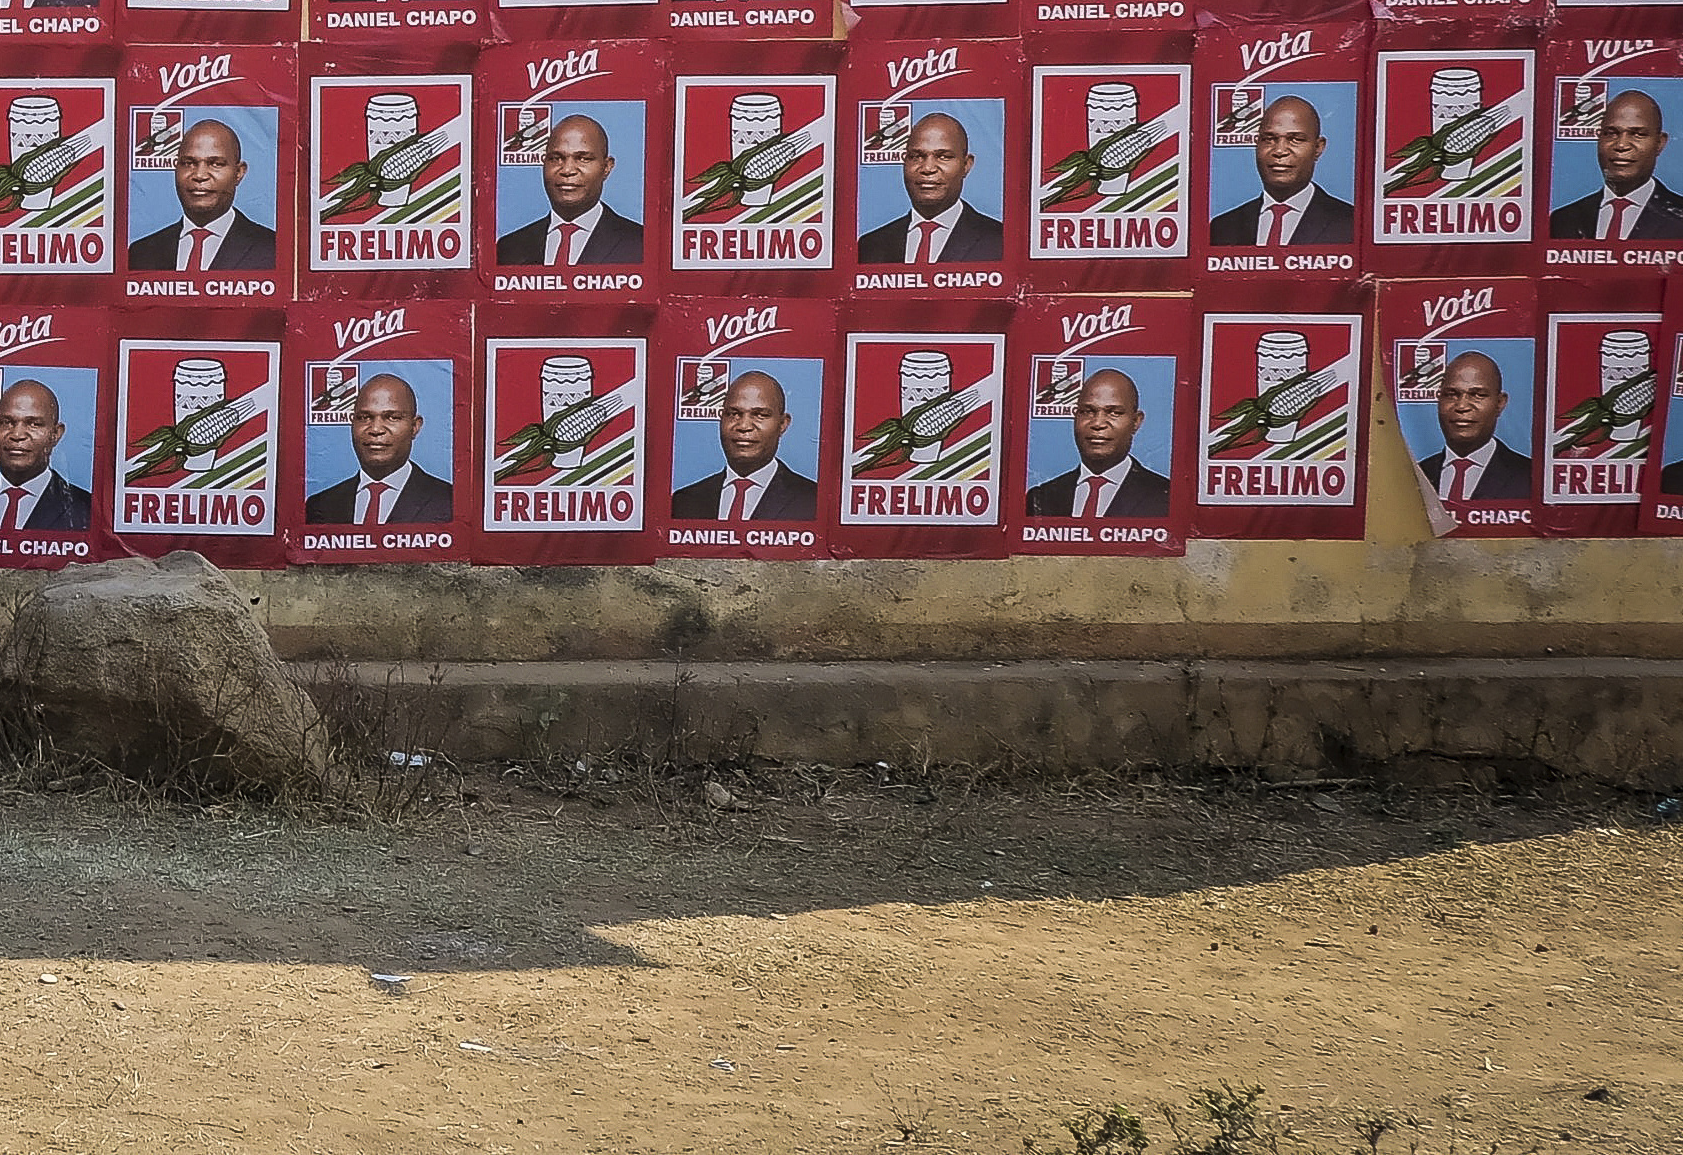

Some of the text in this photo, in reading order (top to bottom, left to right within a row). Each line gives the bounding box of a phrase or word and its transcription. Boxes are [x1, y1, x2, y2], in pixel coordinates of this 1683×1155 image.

[30, 18, 99, 32] CHAPO
[328, 10, 476, 27] DANIEL CHAPO
[671, 10, 814, 26] DANIEL CHAPO
[1039, 2, 1184, 19] DANIEL CHAPO
[1241, 31, 1312, 70] Vota
[159, 54, 231, 93] Vota
[527, 49, 598, 89] Vota
[888, 48, 957, 87] Vota
[1384, 202, 1521, 234] FRELIMO
[320, 229, 461, 260] FRELIMO
[683, 229, 822, 259] FRELIMO
[1040, 218, 1178, 249] FRELIMO
[1208, 255, 1352, 271] DANIEL CHAPO
[1547, 250, 1617, 263] DANIEL
[127, 281, 274, 295] DANIEL CHAPO
[495, 275, 642, 290] DANIEL CHAPO
[857, 273, 1002, 288] DANIEL CHAPO
[1423, 287, 1493, 326] Vota
[334, 309, 404, 348] Vota
[707, 307, 777, 344] Vota
[1062, 305, 1131, 342] Vota
[1207, 466, 1345, 496] FRELIMO
[1553, 464, 1641, 493] FRELI
[124, 493, 265, 525] FRELIMO
[494, 491, 633, 521] FRELIMO
[851, 485, 989, 516] FRELIMO
[20, 541, 88, 556] CHAPO
[305, 534, 451, 549] DANIEL CHAPO
[670, 530, 814, 545] DANIEL CHAPO
[1023, 528, 1167, 541] DANIEL CHAPO
